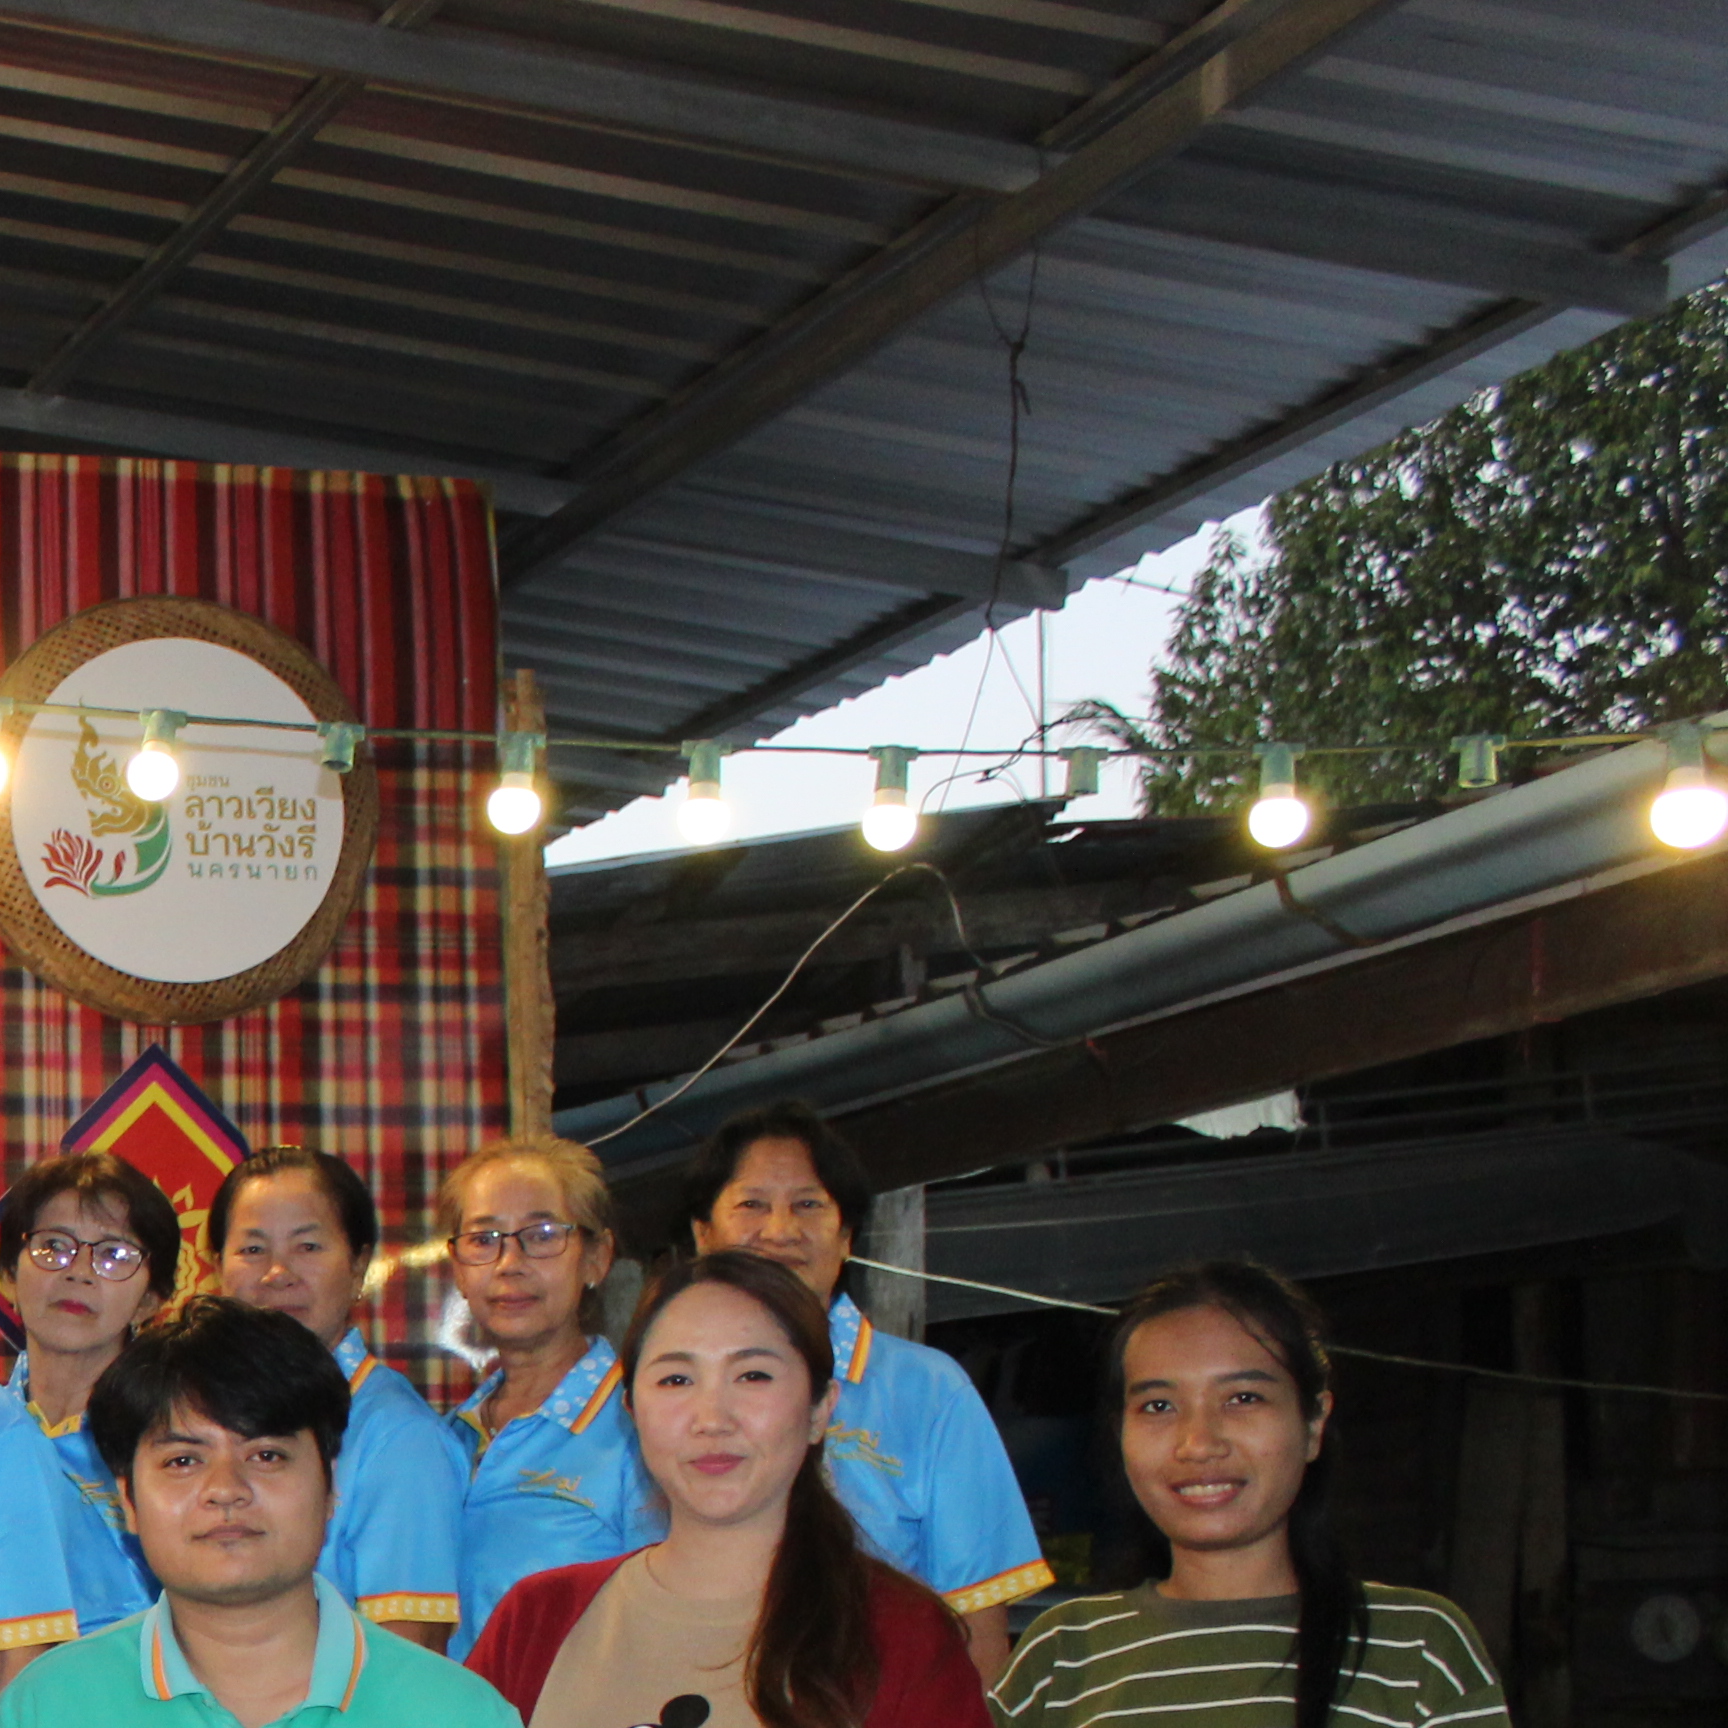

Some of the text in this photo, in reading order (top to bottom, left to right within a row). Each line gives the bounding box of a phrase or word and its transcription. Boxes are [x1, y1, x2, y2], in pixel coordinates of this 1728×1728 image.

[185, 786, 316, 820] ลาวเวียง
[185, 820, 317, 858] บ้านวังรี
[188, 862, 318, 880] นครนายก
